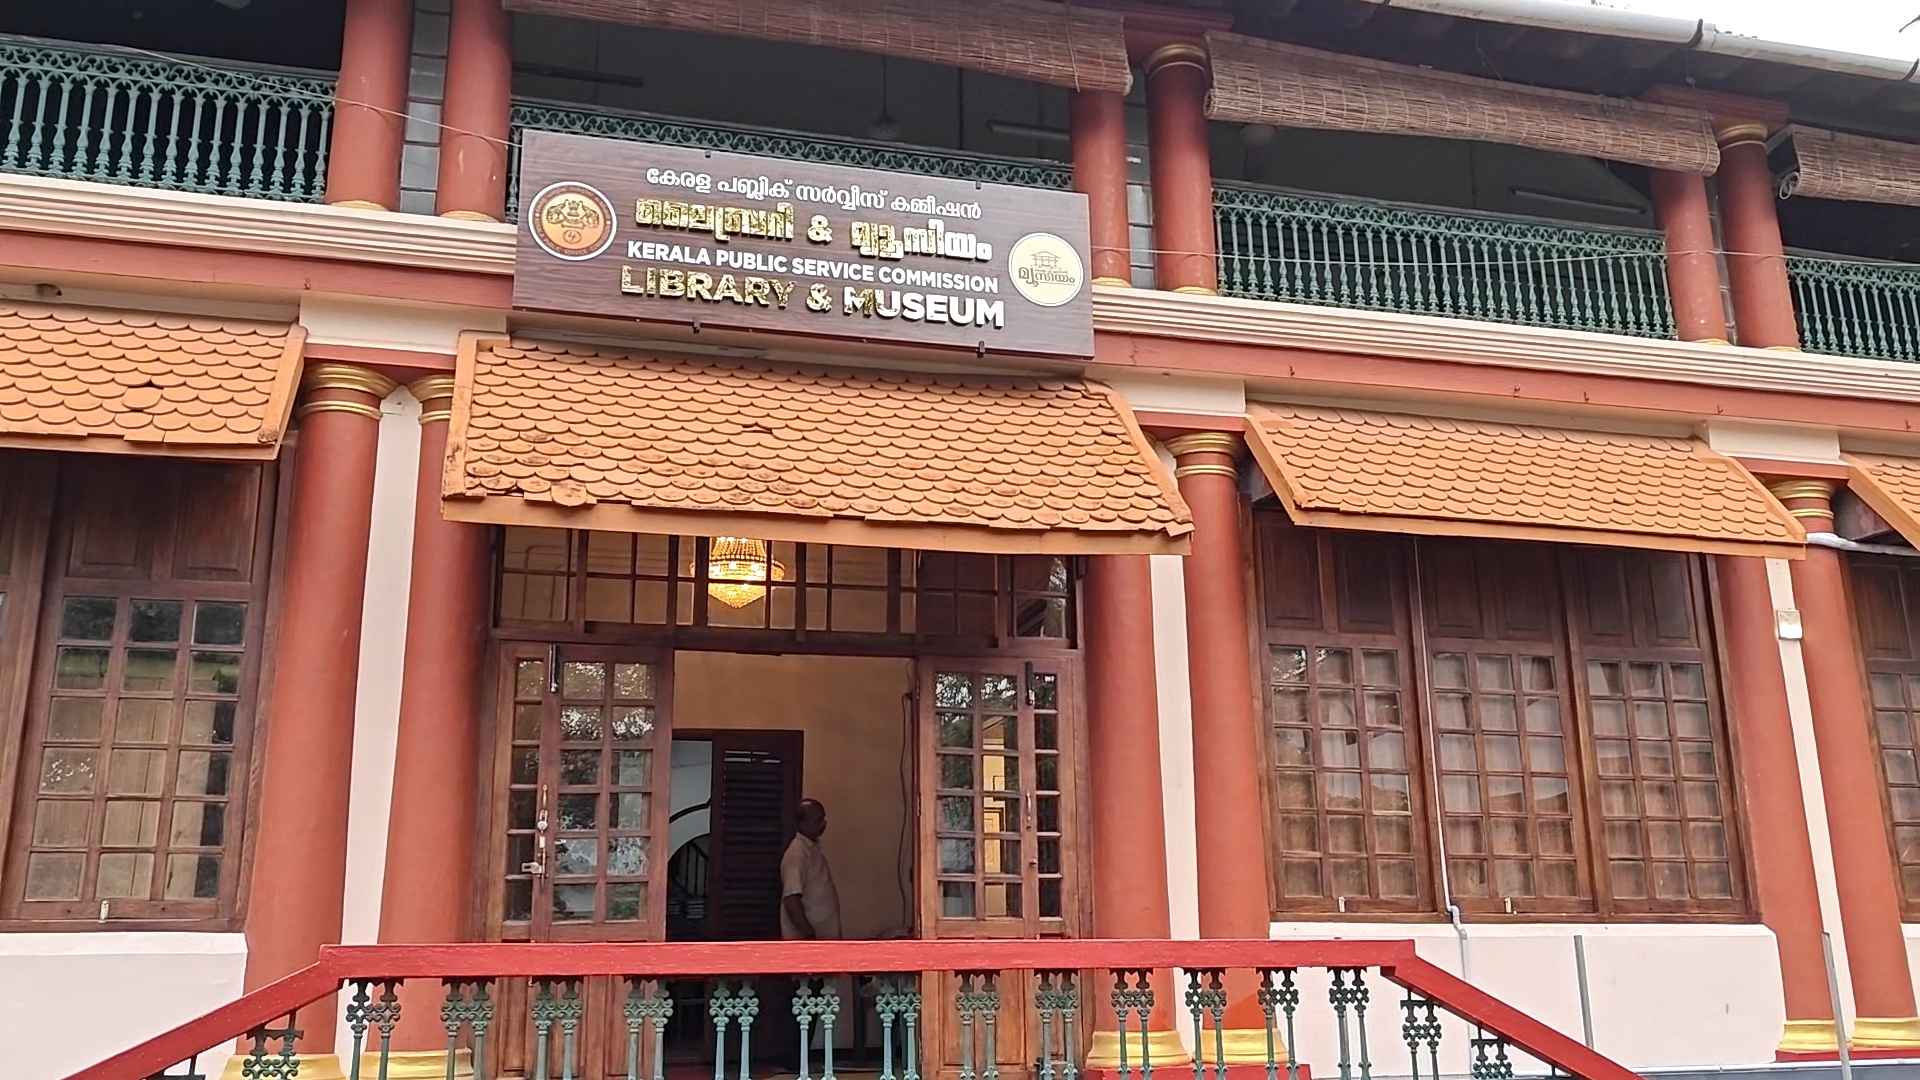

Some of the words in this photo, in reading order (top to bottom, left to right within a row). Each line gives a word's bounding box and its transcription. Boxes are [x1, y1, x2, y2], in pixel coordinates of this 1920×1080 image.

[645, 167, 712, 194] കേരള
[716, 175, 794, 201] പബ്ലിക്
[889, 194, 983, 220] കമ്മീഷൻ
[634, 198, 795, 242] ലൈബ്രറി
[806, 214, 833, 243] &
[851, 218, 993, 261] മ്യൂസിയം
[627, 240, 711, 266] KERALA
[716, 249, 788, 274] PUBLIC
[791, 257, 875, 282] SERVICE
[878, 268, 999, 294] COMMISSION
[1018, 266, 1076, 288] മ്യൂസിയം
[620, 264, 798, 308] LIBRARY
[806, 282, 833, 312] &
[843, 286, 1005, 328] MUSEUM
